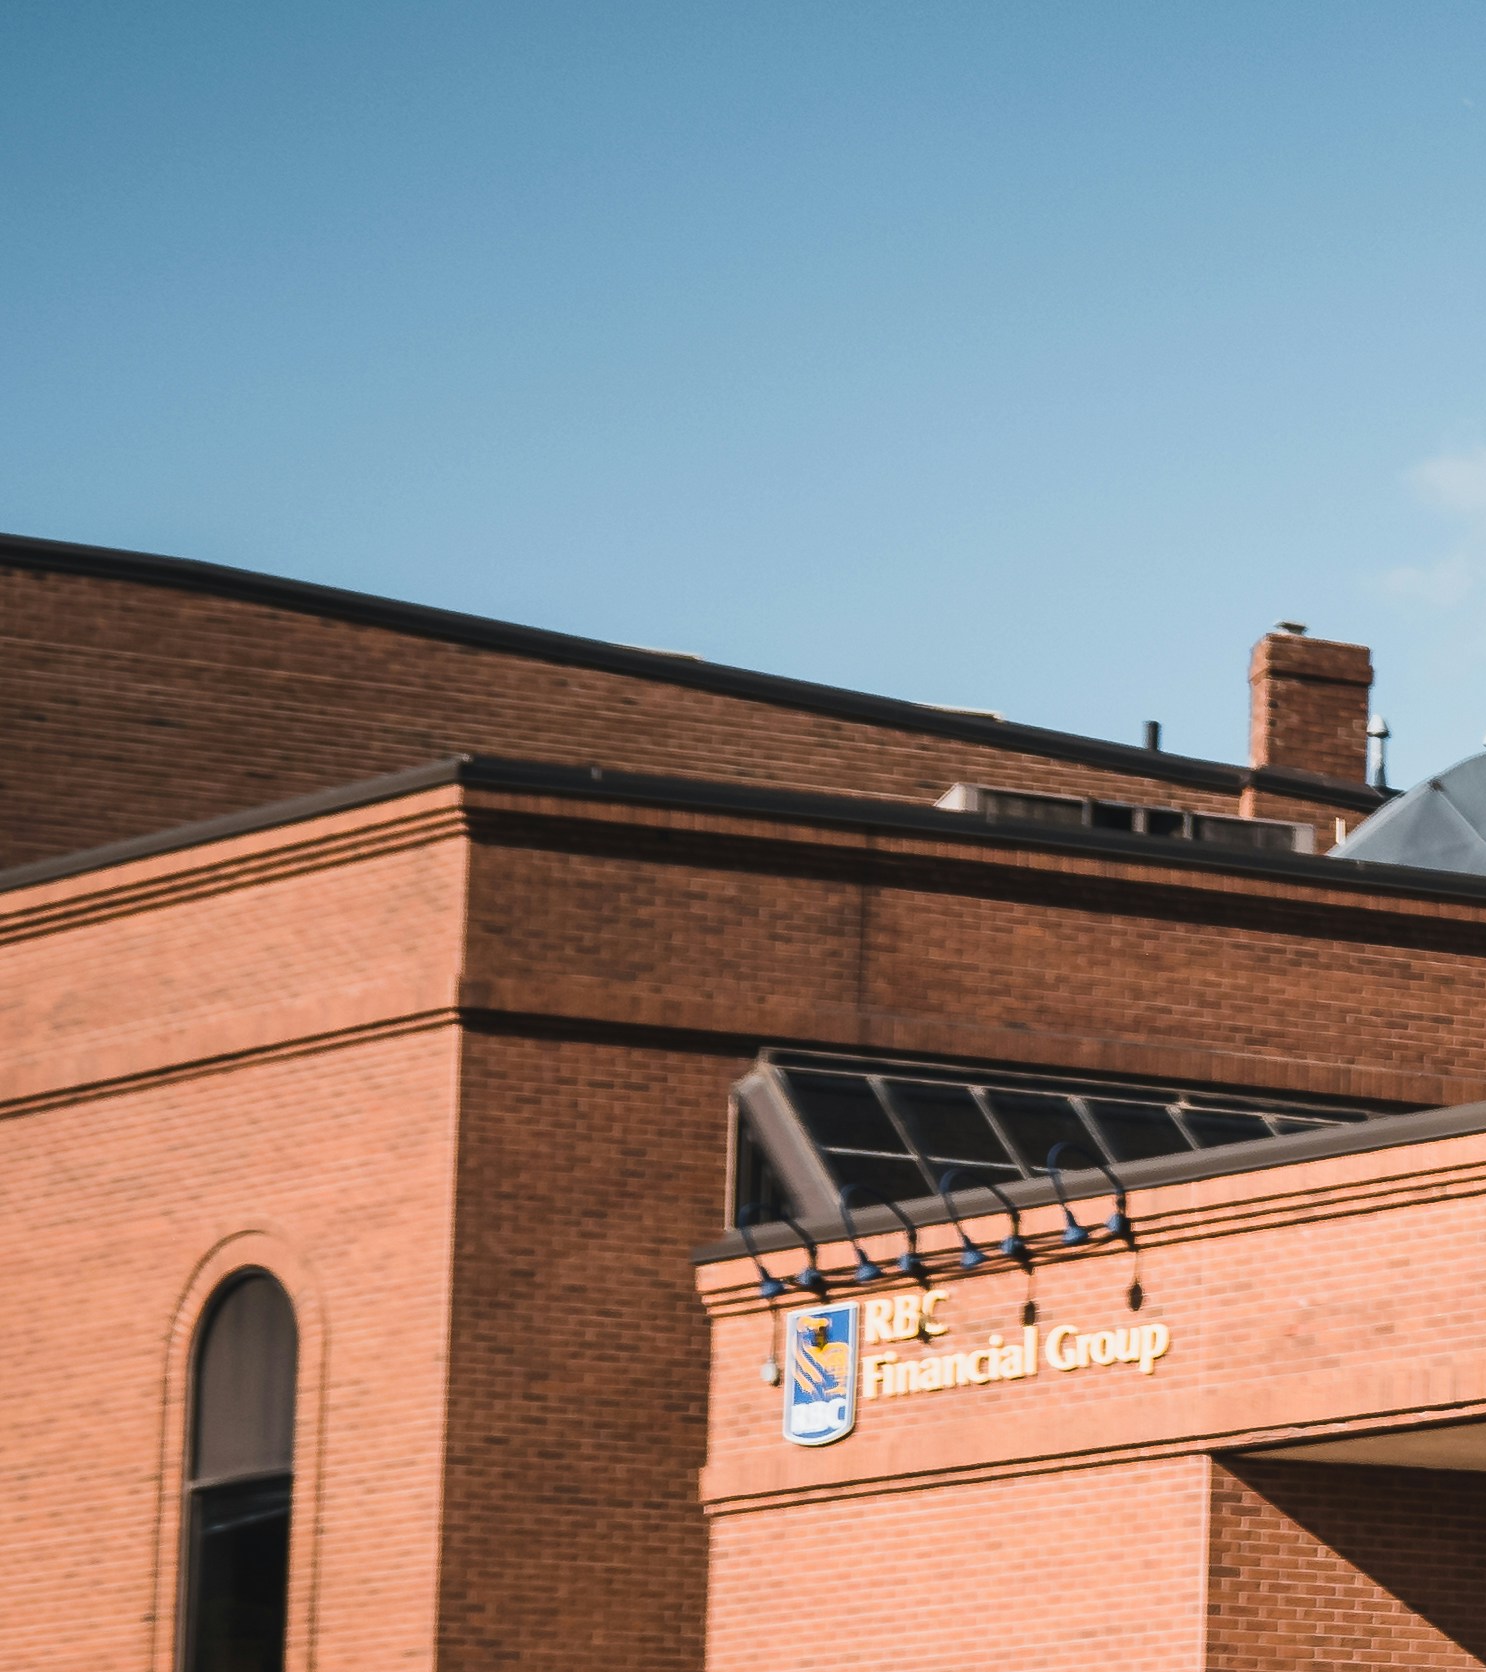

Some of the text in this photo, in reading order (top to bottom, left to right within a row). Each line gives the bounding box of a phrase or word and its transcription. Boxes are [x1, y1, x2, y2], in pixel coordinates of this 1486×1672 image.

[864, 1289, 950, 1344] RBC
[862, 1322, 1170, 1401] Financial Group
